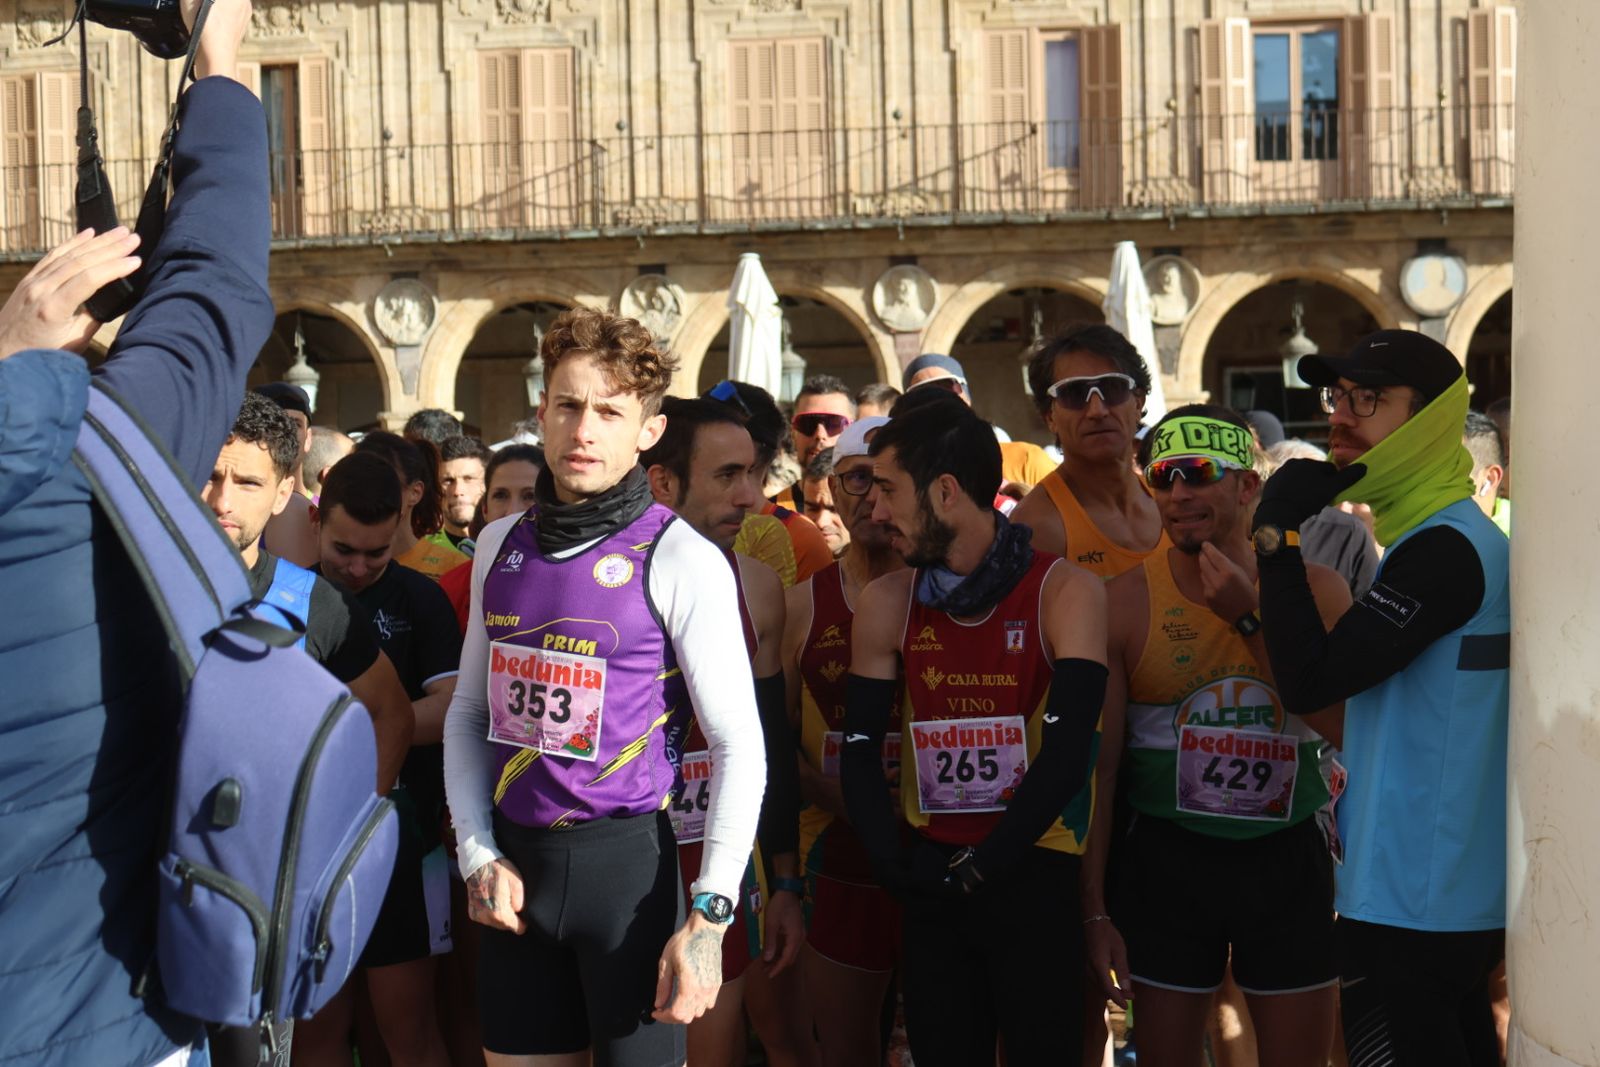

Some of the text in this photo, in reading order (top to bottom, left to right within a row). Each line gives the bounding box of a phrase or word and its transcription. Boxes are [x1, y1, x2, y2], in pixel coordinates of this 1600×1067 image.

[542, 633, 598, 656] PRIM
[491, 647, 603, 690] bedunia
[947, 674, 1018, 686] CAJA RURAL
[508, 680, 572, 724] 353
[946, 698, 995, 713] VINO
[912, 723, 1023, 749] bedunia
[1181, 729, 1296, 762] bedunia
[936, 749, 999, 783] 265
[1202, 756, 1273, 793] 429
